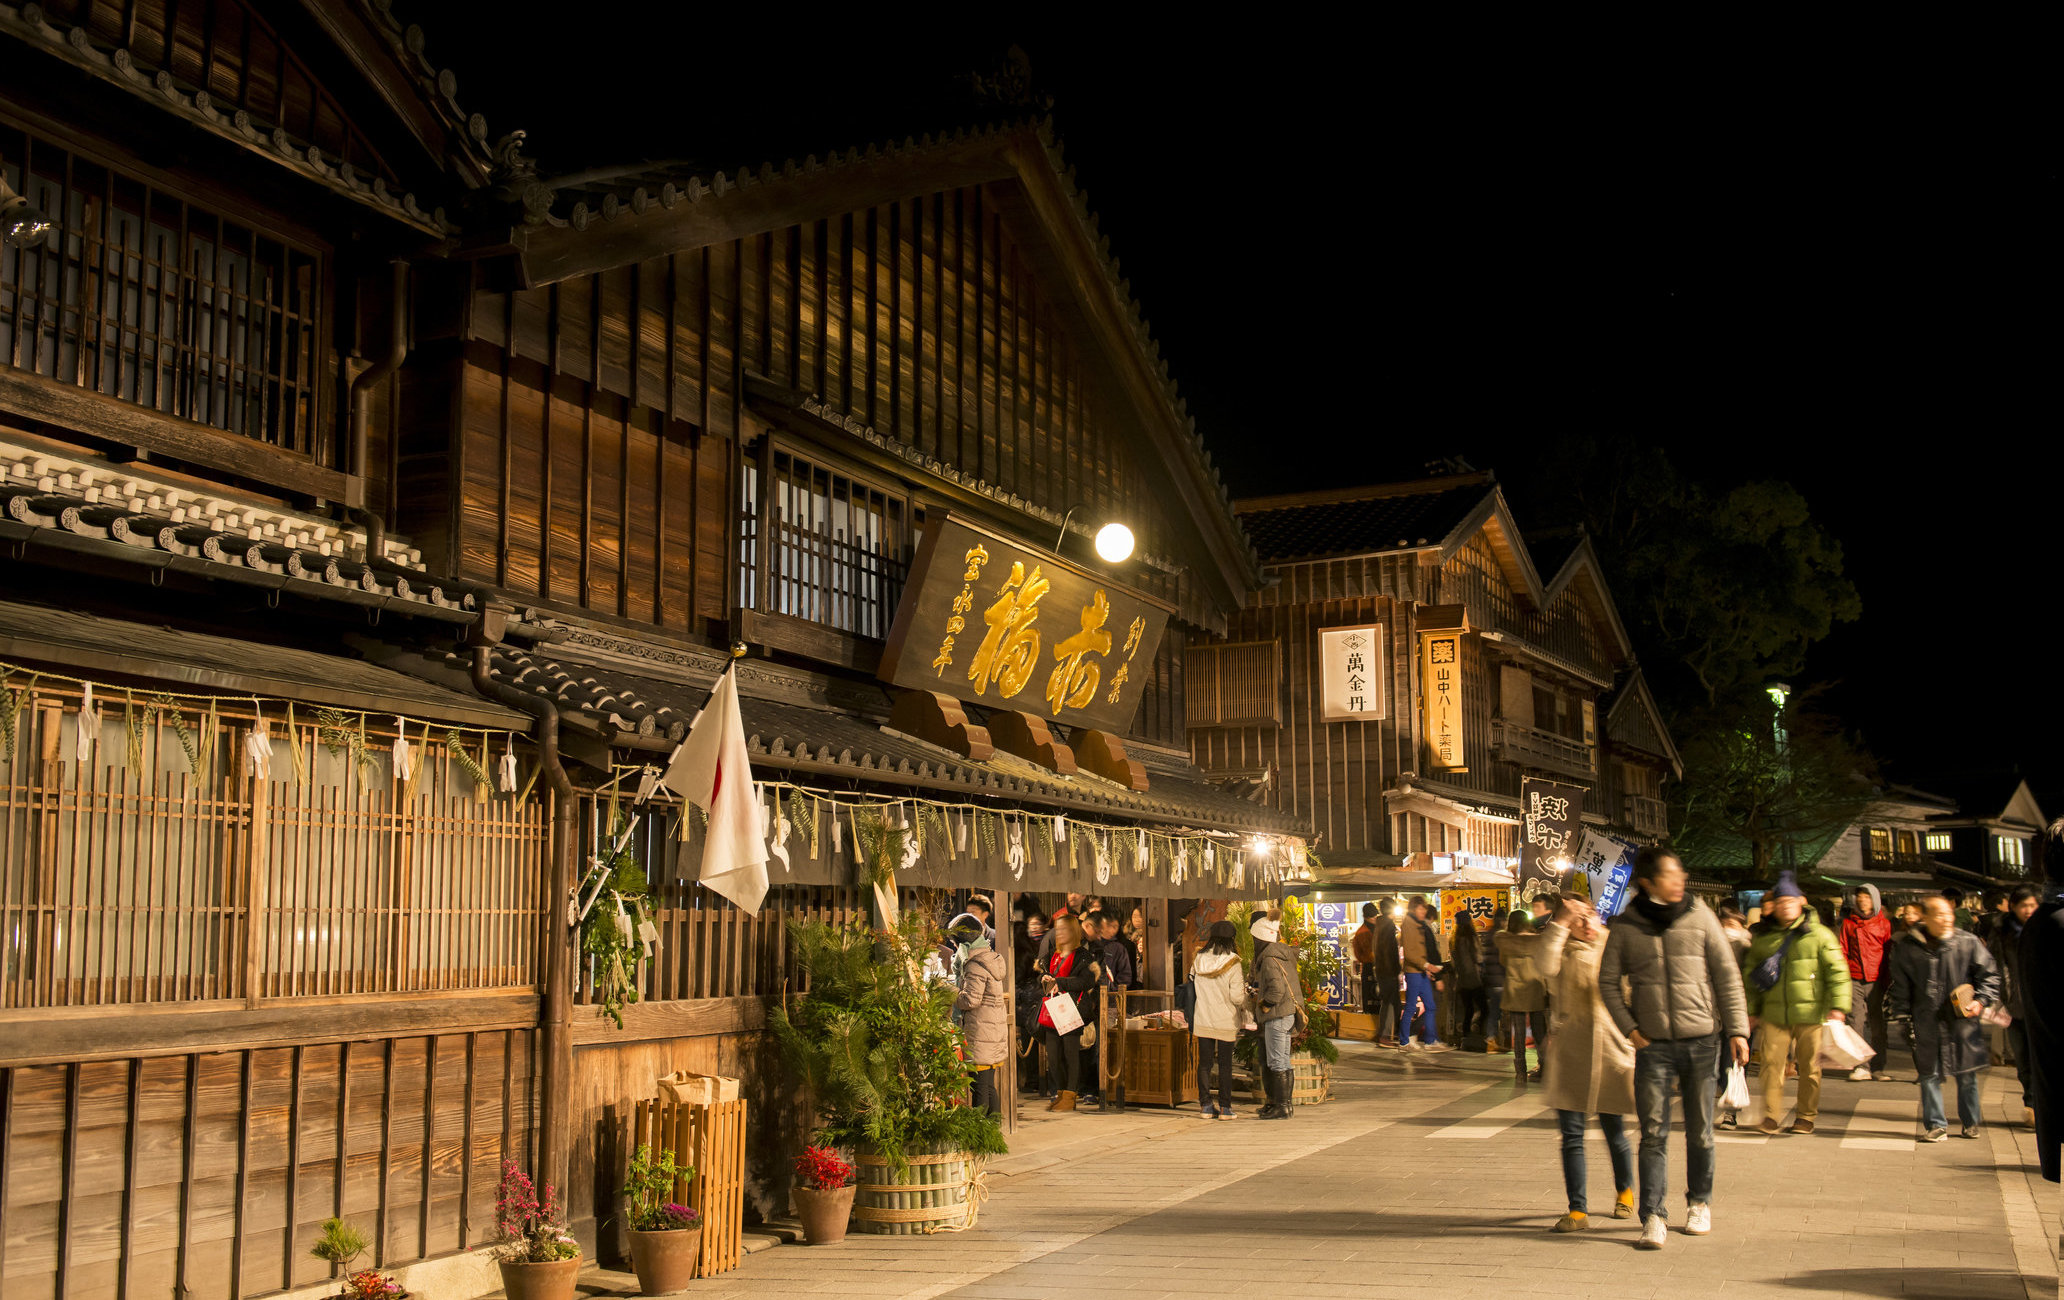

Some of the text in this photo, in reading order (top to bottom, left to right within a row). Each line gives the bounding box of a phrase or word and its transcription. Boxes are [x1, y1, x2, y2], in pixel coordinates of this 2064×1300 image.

[1346, 653, 1367, 713] 萬金丹
[1437, 668, 1452, 761] 山中ハート薬局
